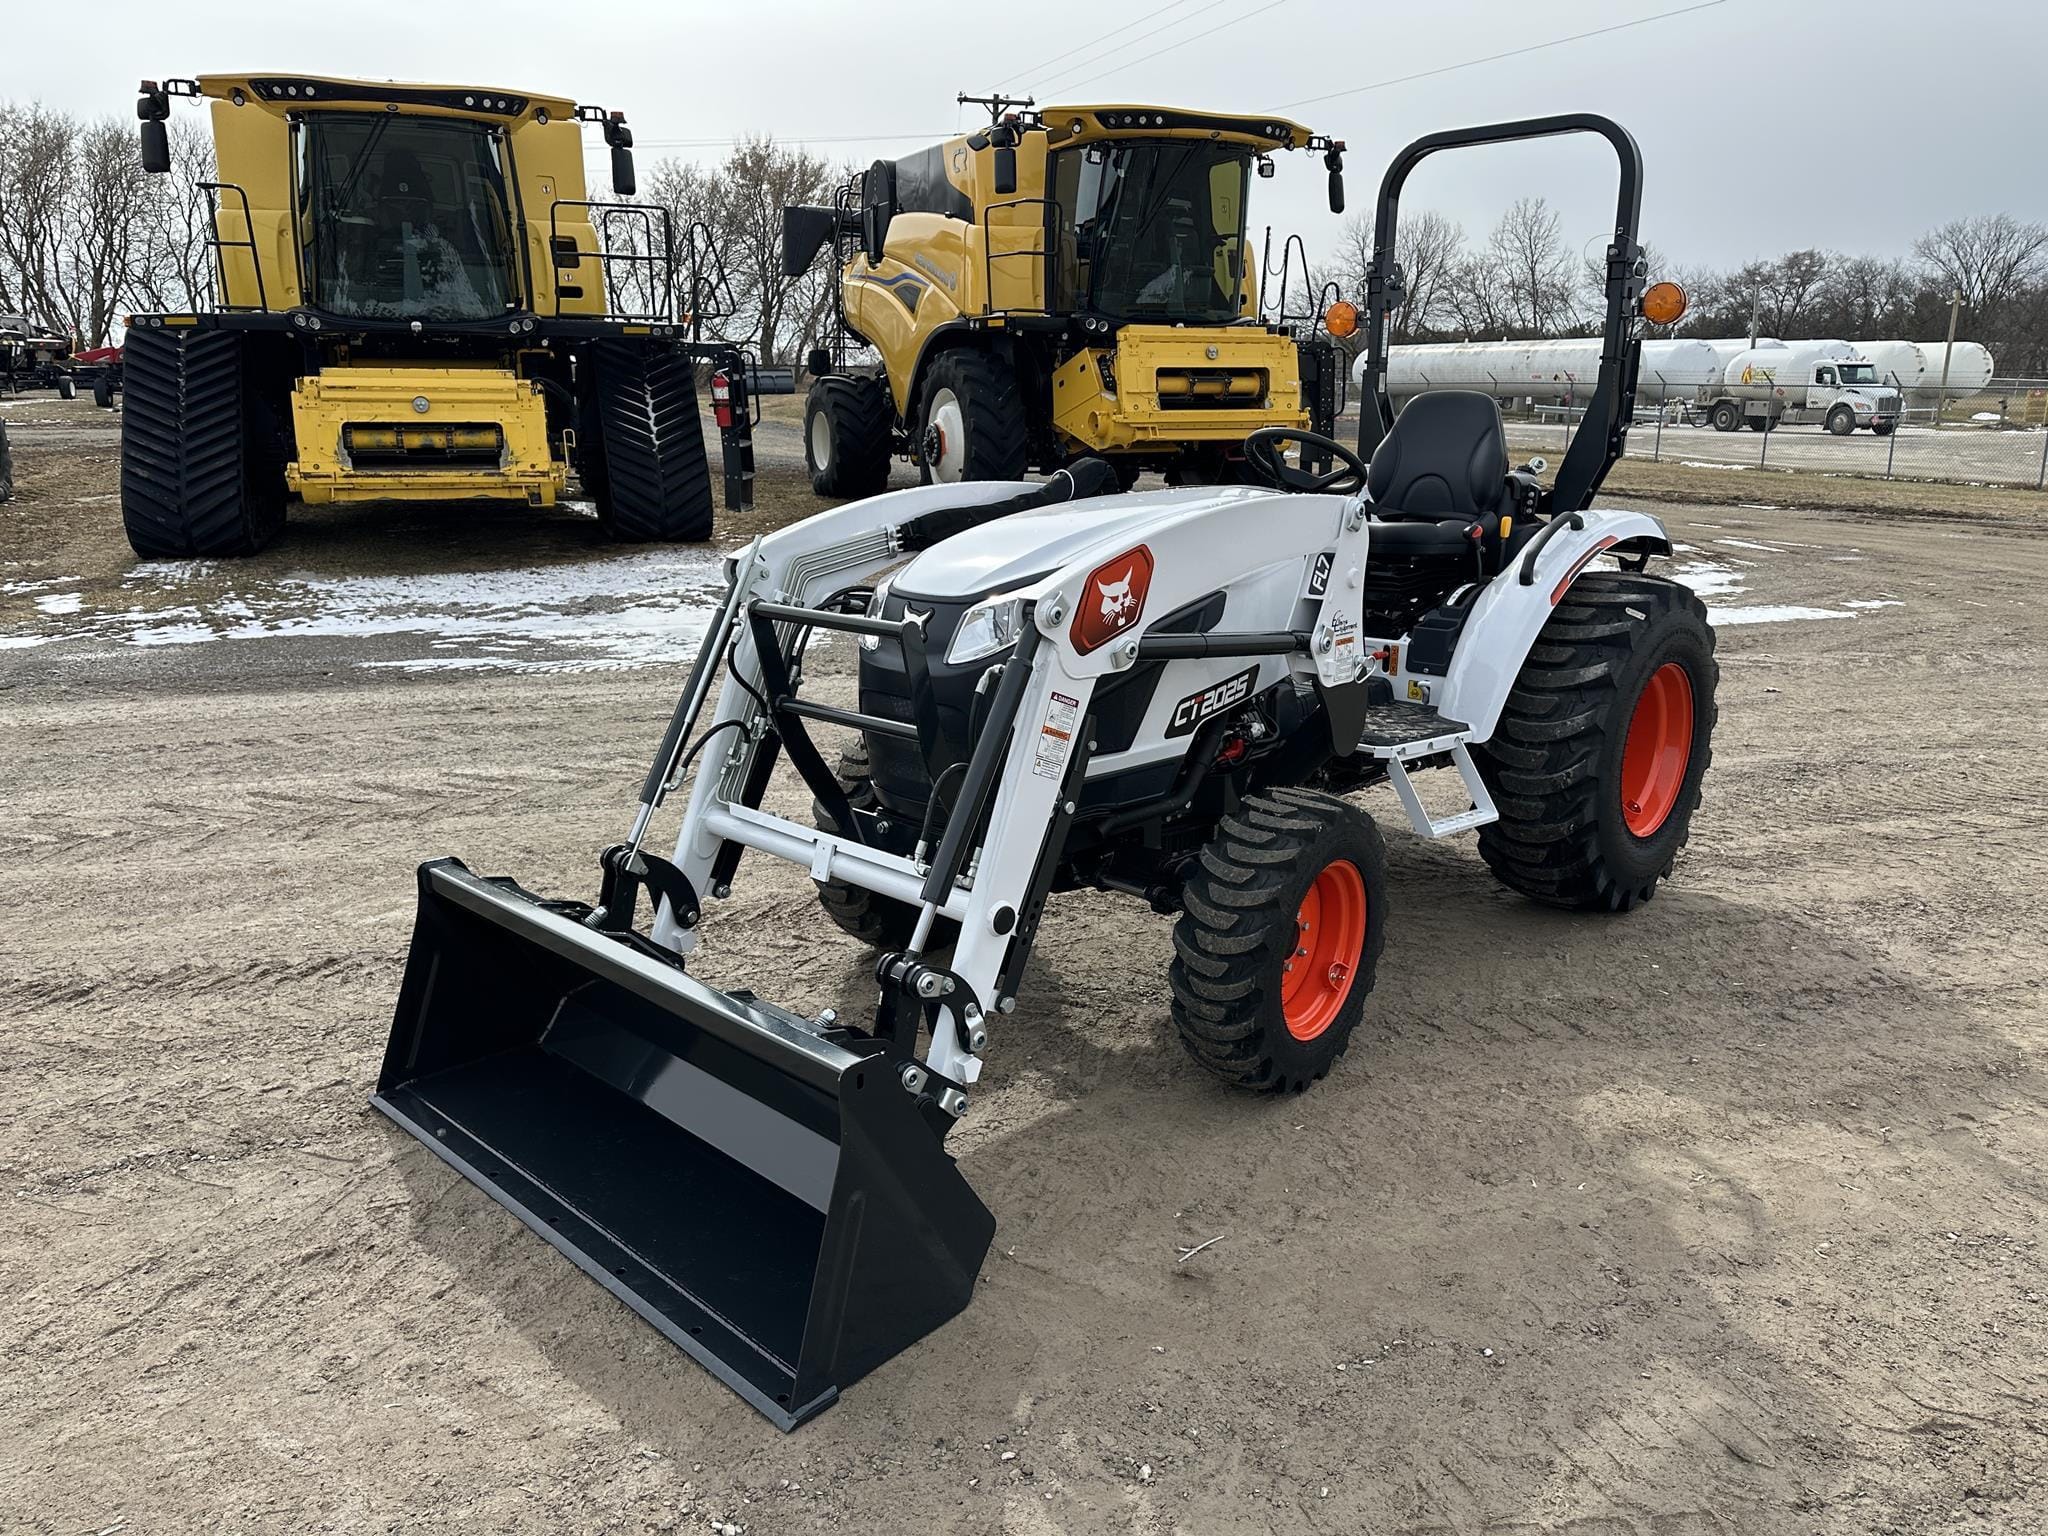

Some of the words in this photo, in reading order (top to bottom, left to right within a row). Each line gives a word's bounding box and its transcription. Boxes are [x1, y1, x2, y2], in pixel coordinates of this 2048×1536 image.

[1312, 554, 1330, 591] FL7
[1058, 696, 1077, 706] DANGER
[1174, 673, 1250, 727] CT2025
